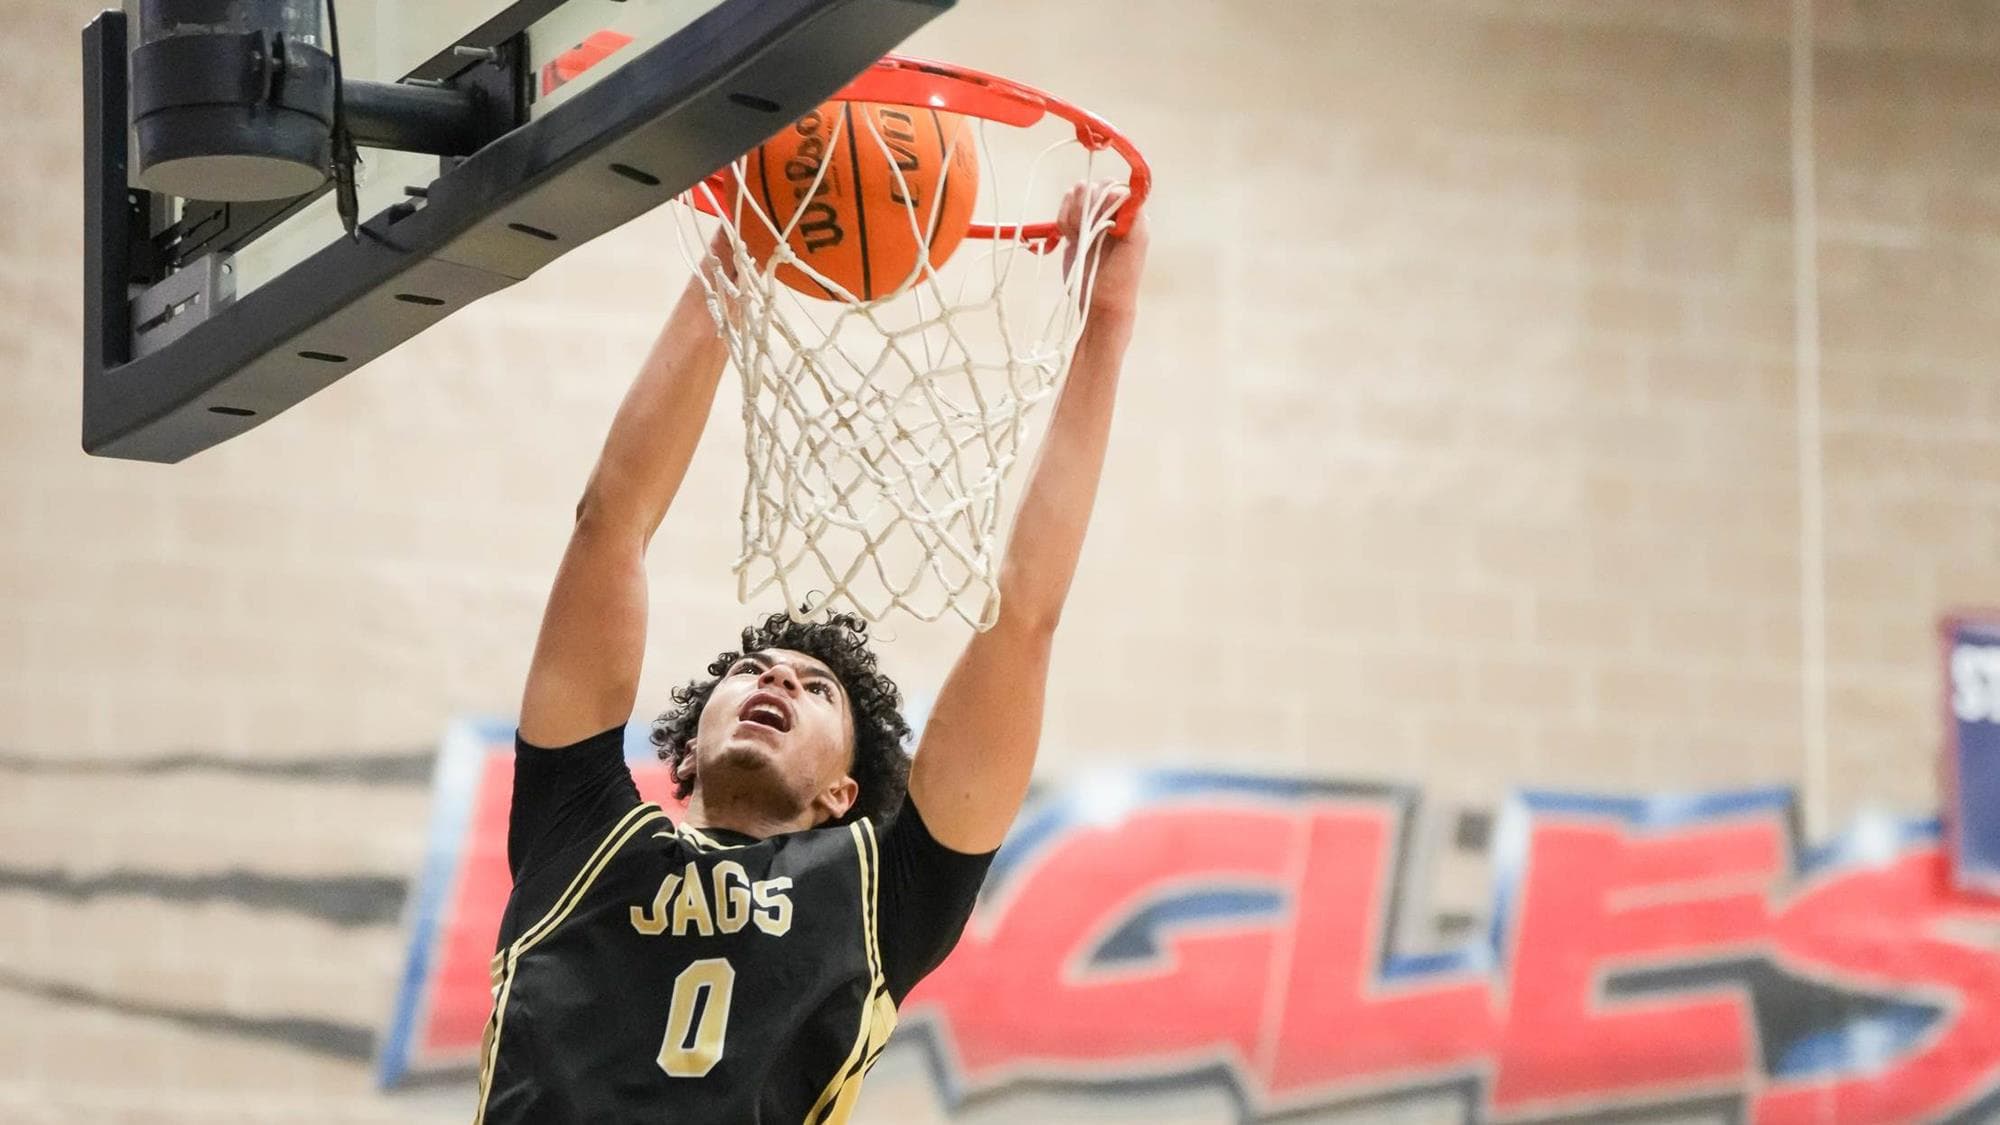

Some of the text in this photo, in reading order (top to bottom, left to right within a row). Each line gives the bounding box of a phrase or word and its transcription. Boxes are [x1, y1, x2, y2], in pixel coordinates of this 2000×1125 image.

[785, 109, 844, 254] Wilso
[878, 108, 920, 209] EVO
[629, 860, 793, 937] JAGS
[656, 957, 736, 1078] 0
